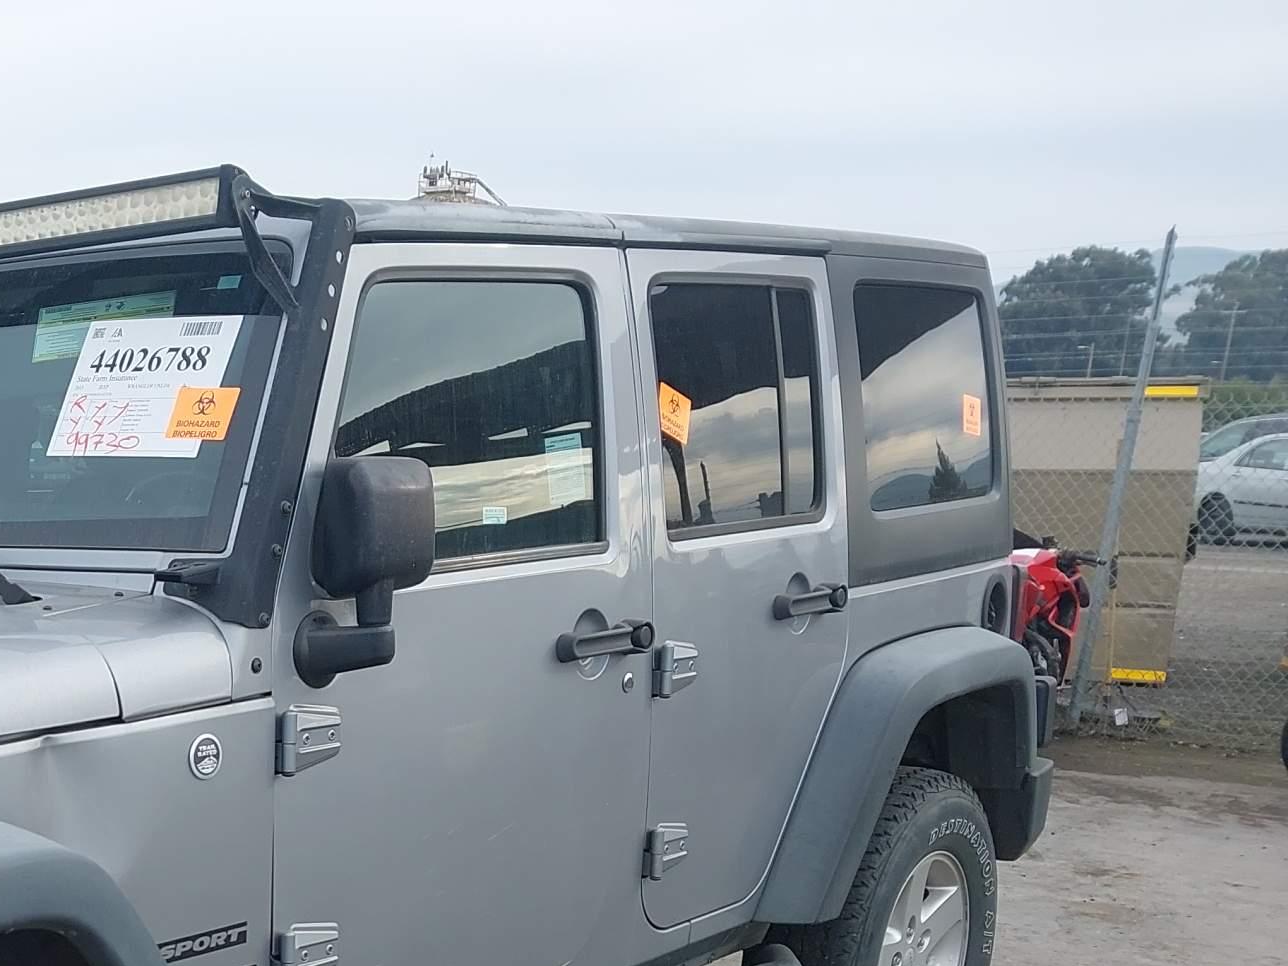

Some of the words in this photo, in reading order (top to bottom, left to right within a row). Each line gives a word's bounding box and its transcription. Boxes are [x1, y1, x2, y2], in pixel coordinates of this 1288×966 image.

[89, 345, 211, 374] 44026788
[175, 420, 221, 428] BIOHAZARD
[929, 818, 995, 896] DESTINATION
[160, 926, 247, 960] SPORT
